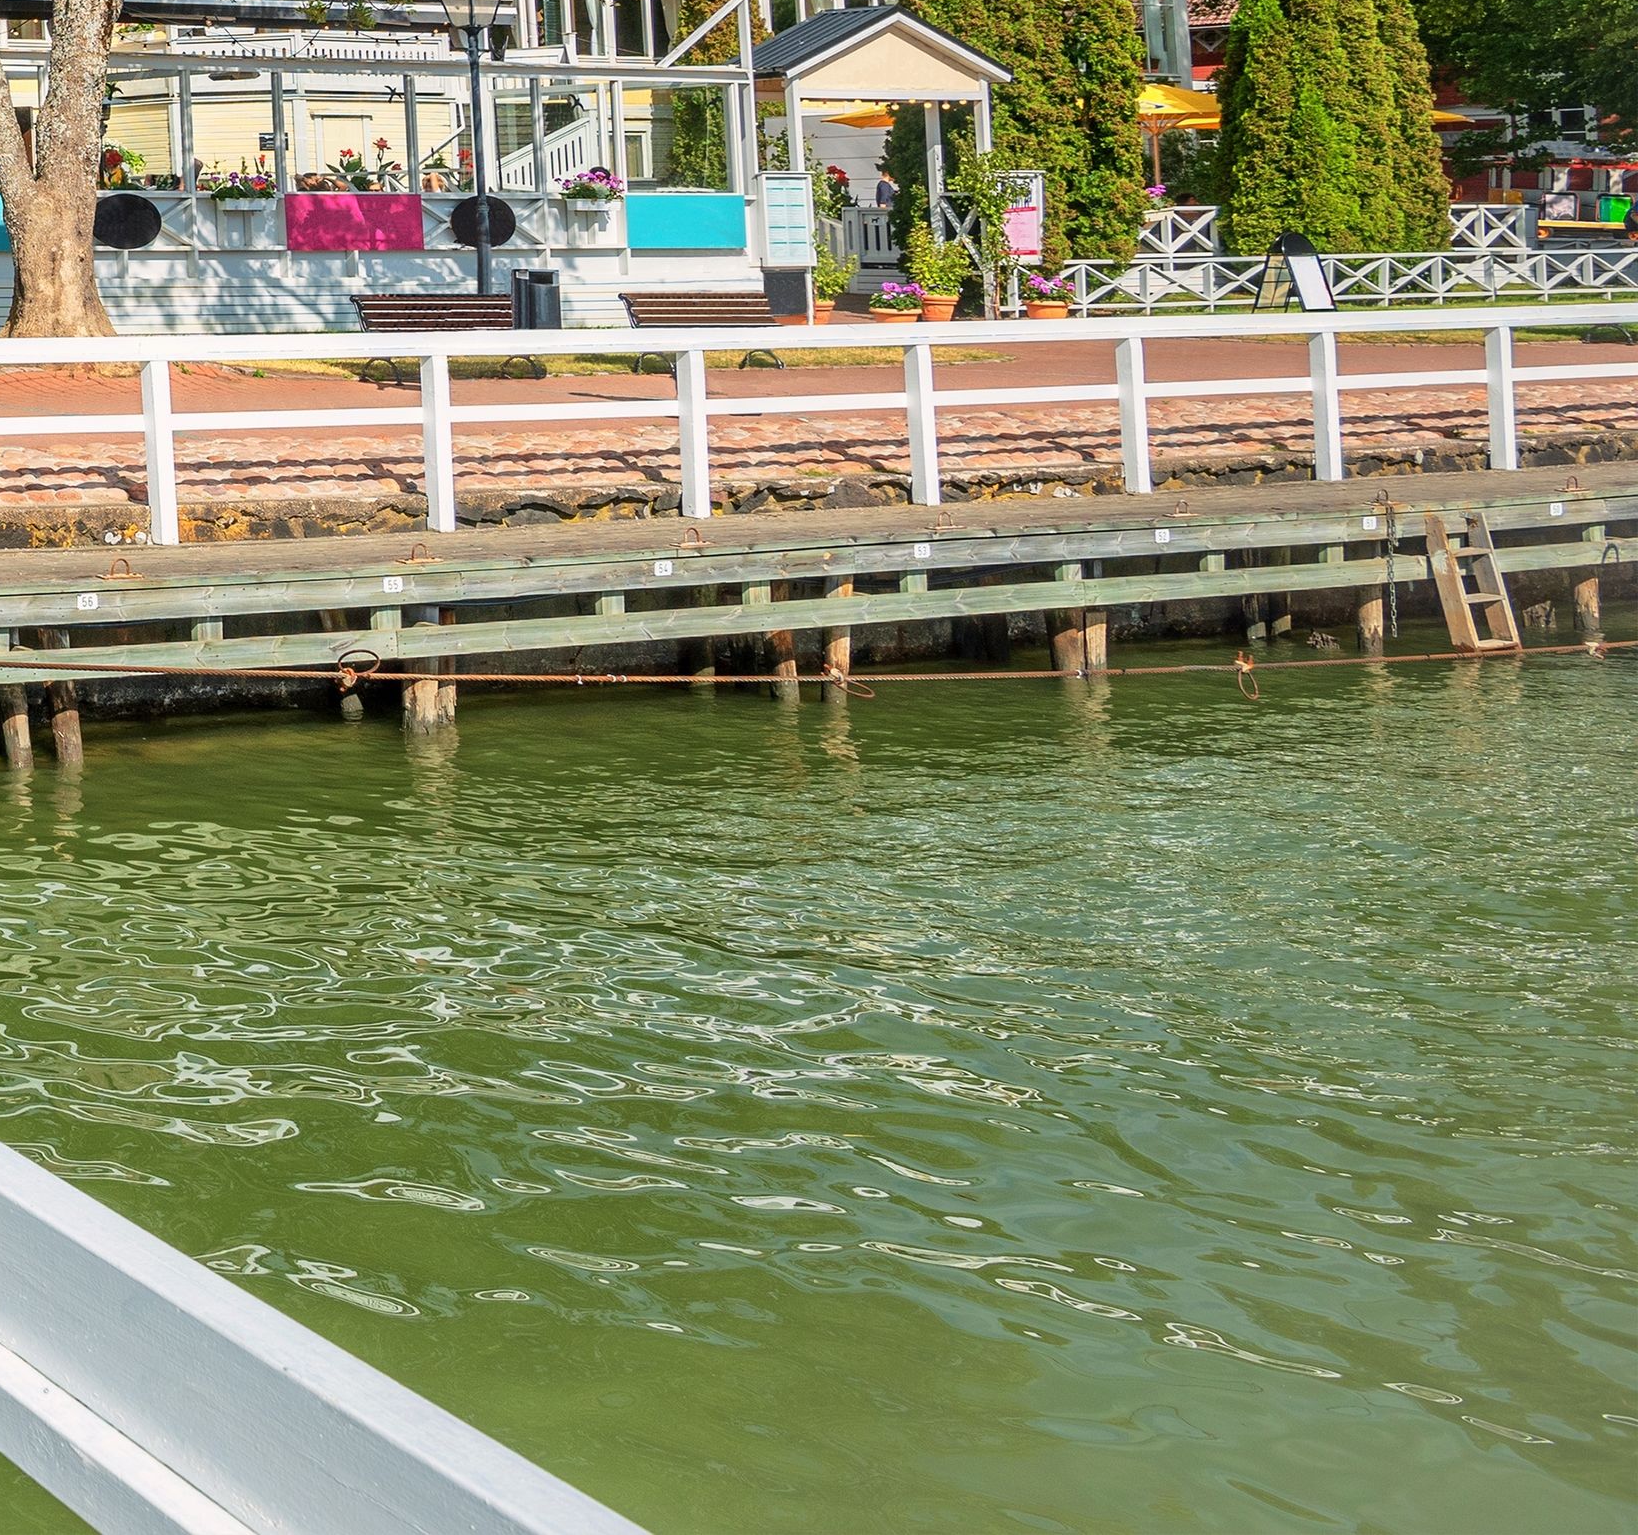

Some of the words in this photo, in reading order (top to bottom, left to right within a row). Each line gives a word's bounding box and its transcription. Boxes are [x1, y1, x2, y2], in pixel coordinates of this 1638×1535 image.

[659, 563, 669, 574] 54
[388, 579, 399, 590] 55
[82, 596, 93, 607] 56
